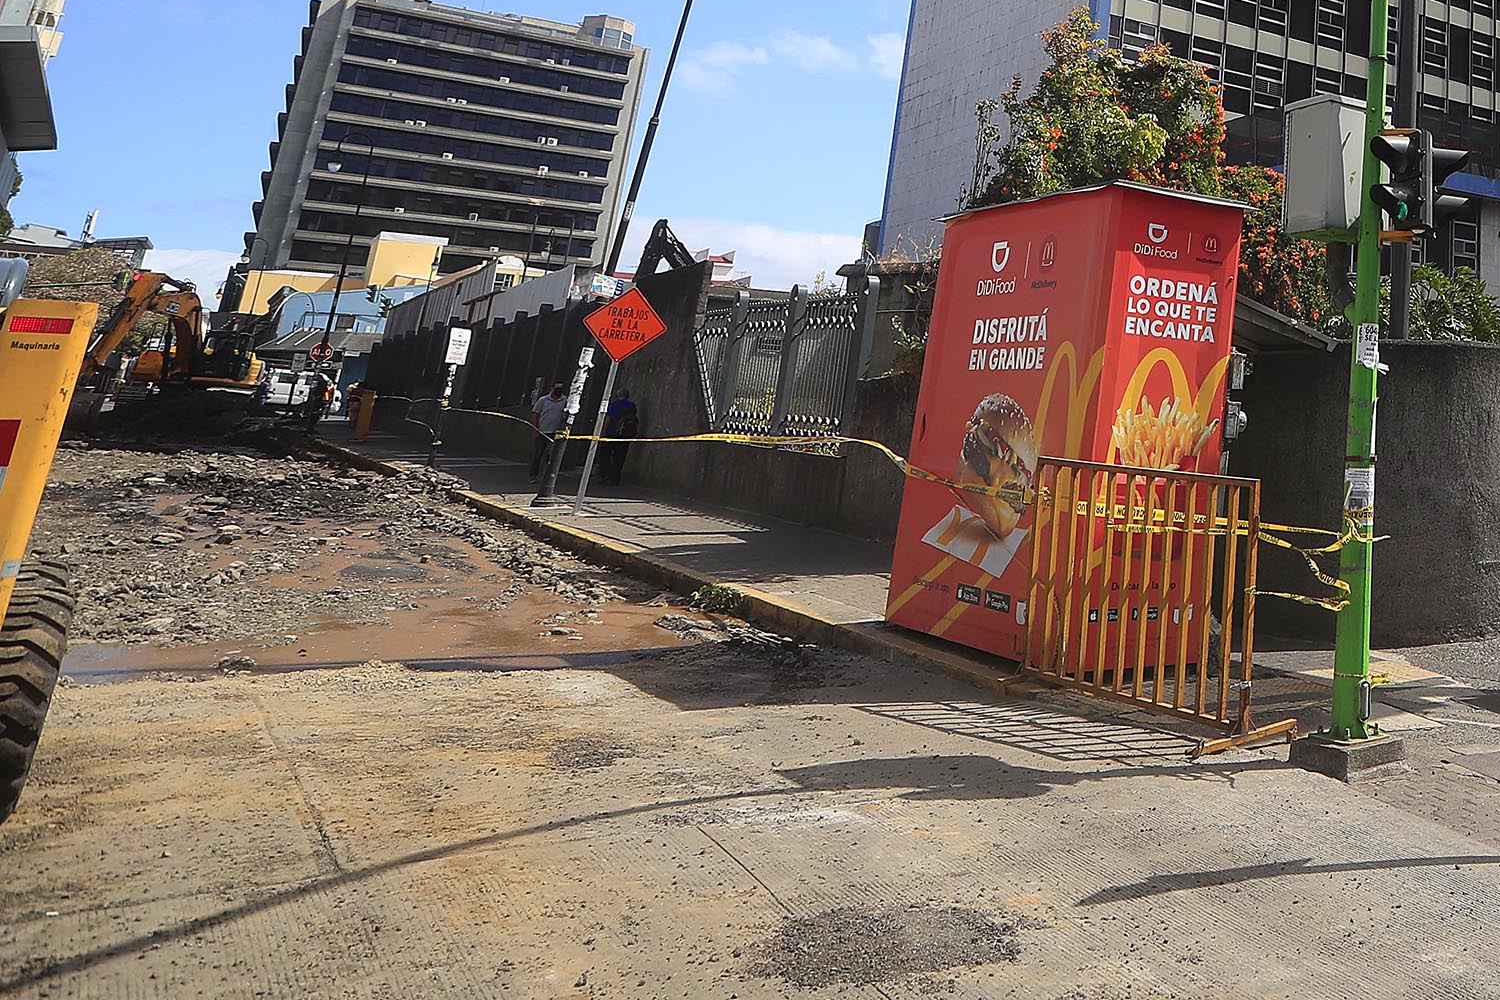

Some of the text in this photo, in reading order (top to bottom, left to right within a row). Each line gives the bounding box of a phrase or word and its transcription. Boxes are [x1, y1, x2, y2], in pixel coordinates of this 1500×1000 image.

[1129, 275, 1218, 305] ORDENÁ
[607, 306, 649, 321] TRABAJOS
[1127, 296, 1217, 323] LO QUE TE
[611, 318, 638, 331] EN LA
[972, 308, 1049, 345] DISFRUTÁ
[1125, 316, 1215, 343] ENCANTA
[598, 328, 646, 342] CARRETERA
[10, 341, 61, 351] Maquinaria
[312, 348, 332, 356] ALO
[968, 346, 1045, 371] EN GRANDE
